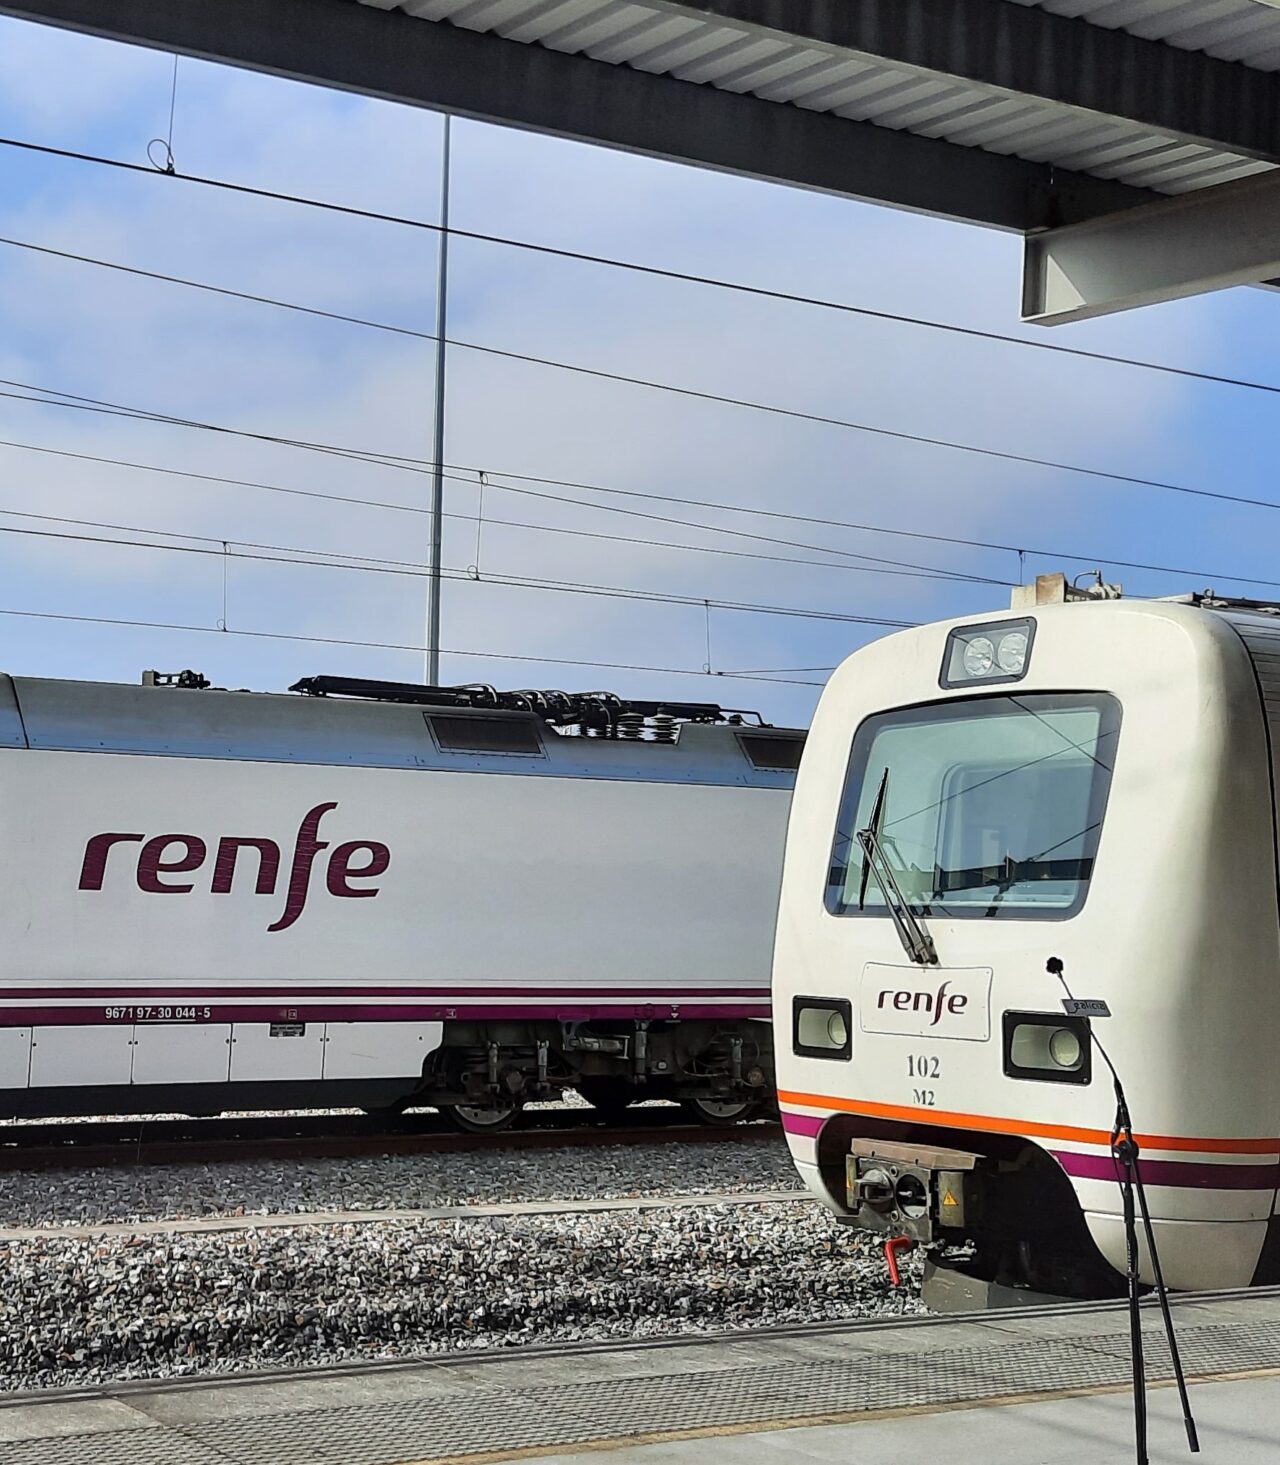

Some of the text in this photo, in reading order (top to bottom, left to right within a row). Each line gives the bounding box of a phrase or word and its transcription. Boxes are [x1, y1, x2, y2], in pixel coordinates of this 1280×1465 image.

[77, 801, 391, 932] renfe
[877, 980, 968, 1026] renfe
[907, 1054, 941, 1079] 102
[913, 1088, 936, 1106] M2
